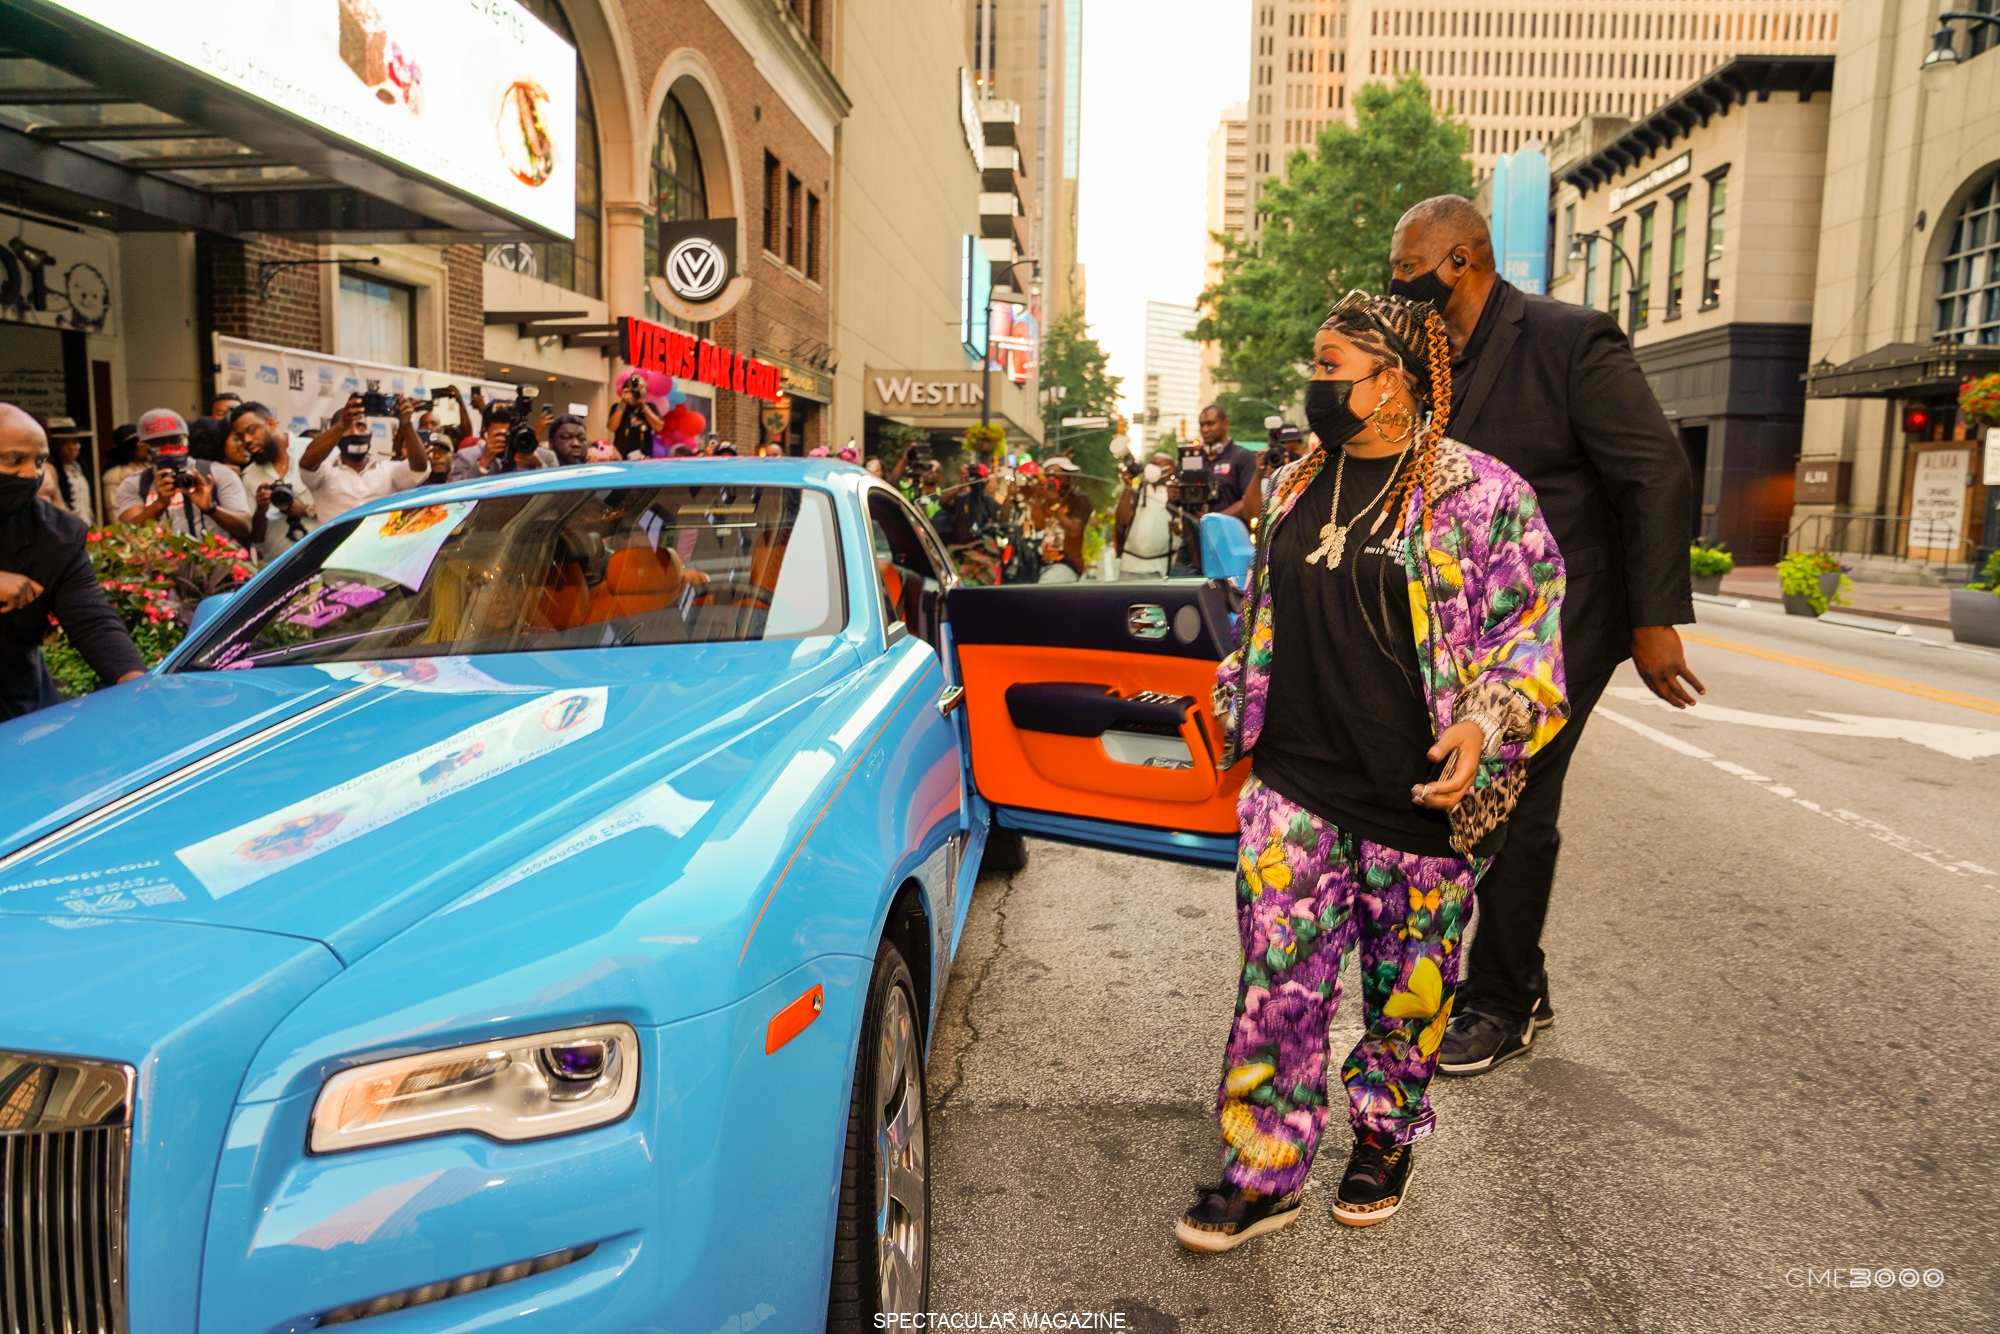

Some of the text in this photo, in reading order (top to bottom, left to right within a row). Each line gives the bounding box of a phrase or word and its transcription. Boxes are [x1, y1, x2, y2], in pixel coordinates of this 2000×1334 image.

[470, 0, 525, 44] vents
[1505, 261, 1529, 277] FOR
[628, 315, 696, 380] VIEWS
[698, 338, 732, 391] BAR
[733, 352, 745, 393] &
[746, 357, 782, 404] GRILL
[288, 368, 304, 388] WE
[1925, 453, 1957, 470] ALMA
[1804, 471, 1828, 483] ALMA
